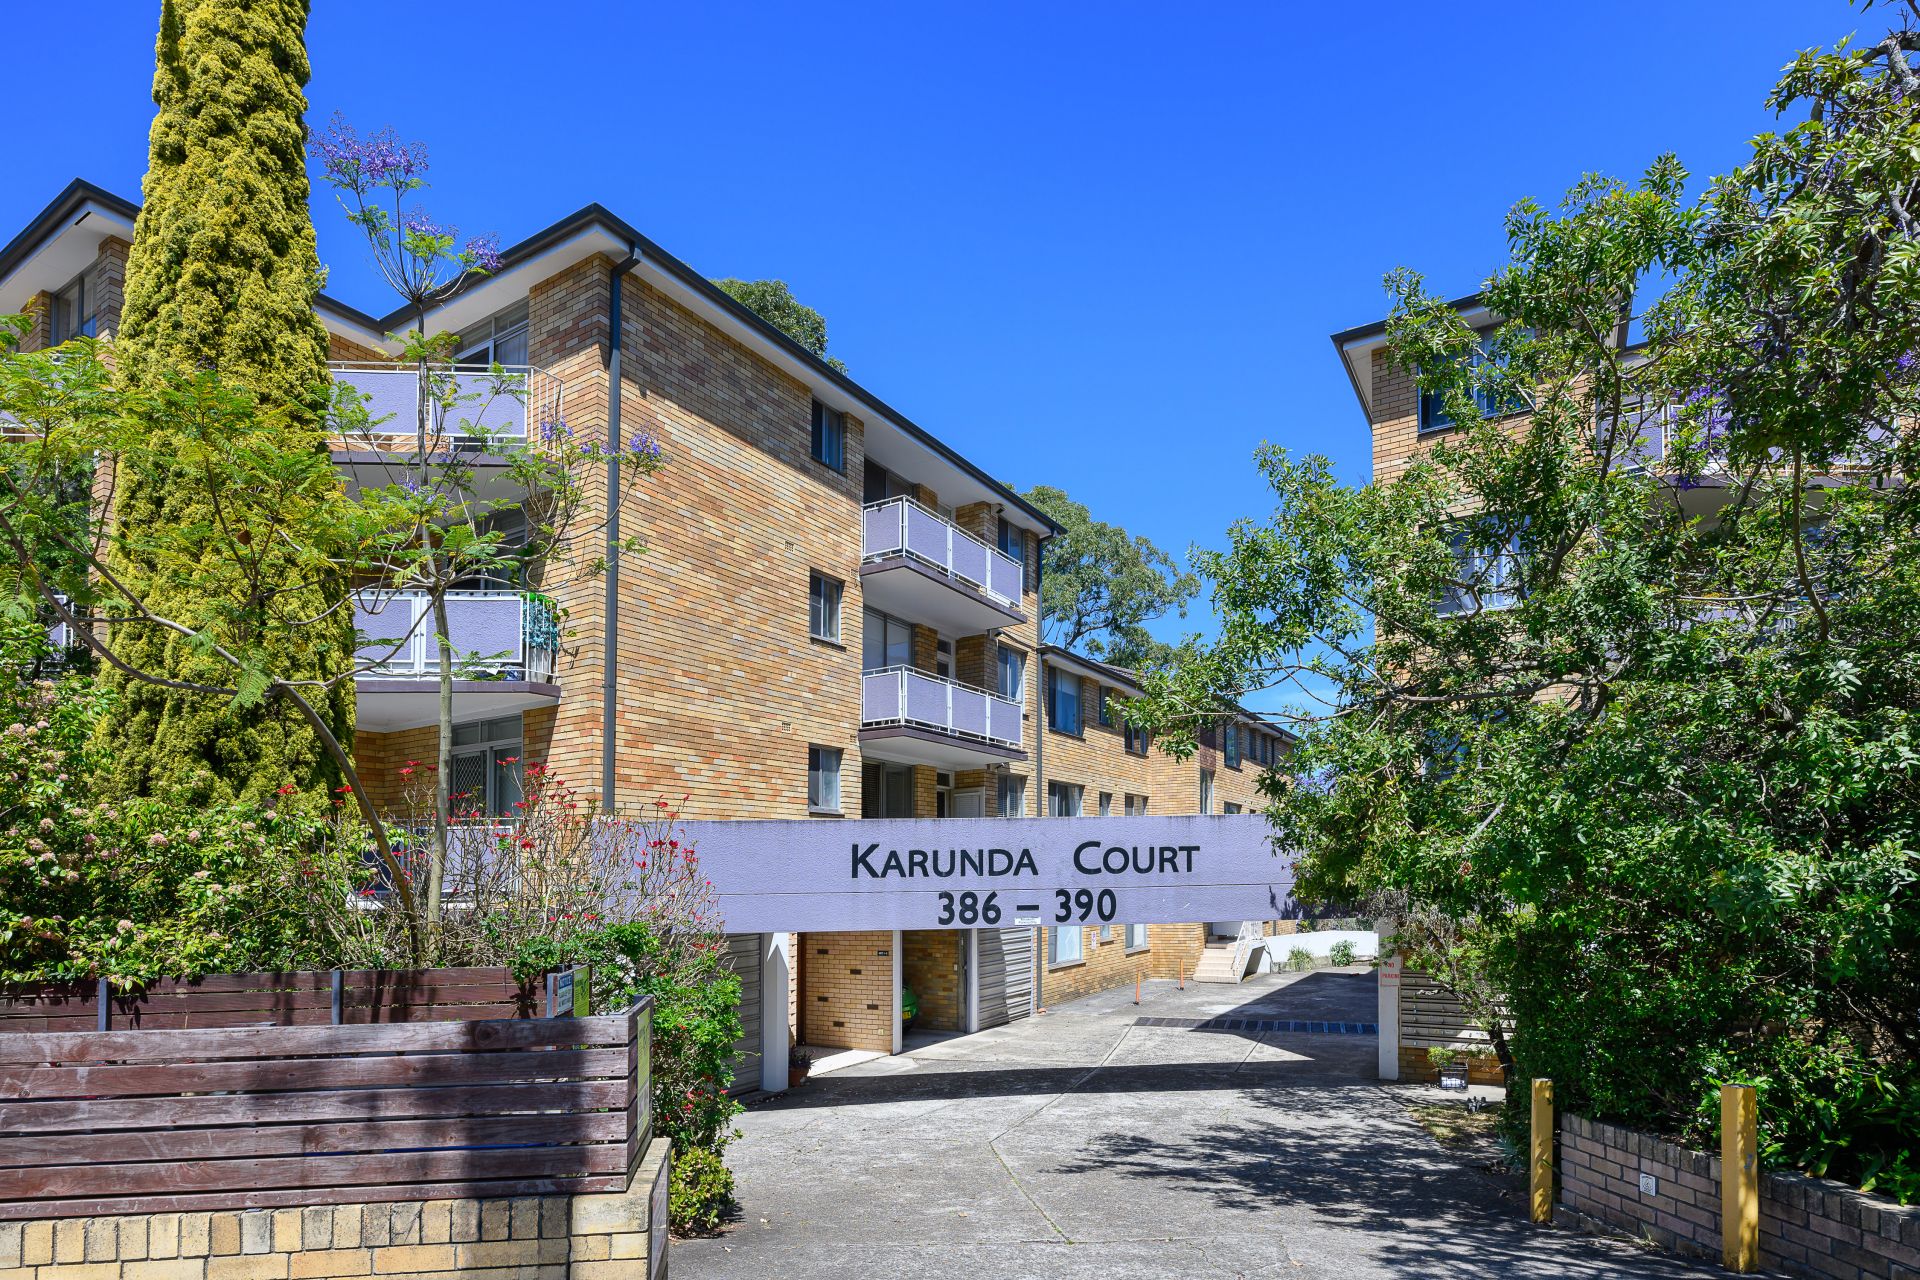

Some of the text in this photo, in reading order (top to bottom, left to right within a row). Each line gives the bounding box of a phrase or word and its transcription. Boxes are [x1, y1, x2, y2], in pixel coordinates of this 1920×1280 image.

[851, 840, 1201, 879] KARUNDA COURT
[938, 890, 1001, 926] 386
[1055, 888, 1117, 923] 390
